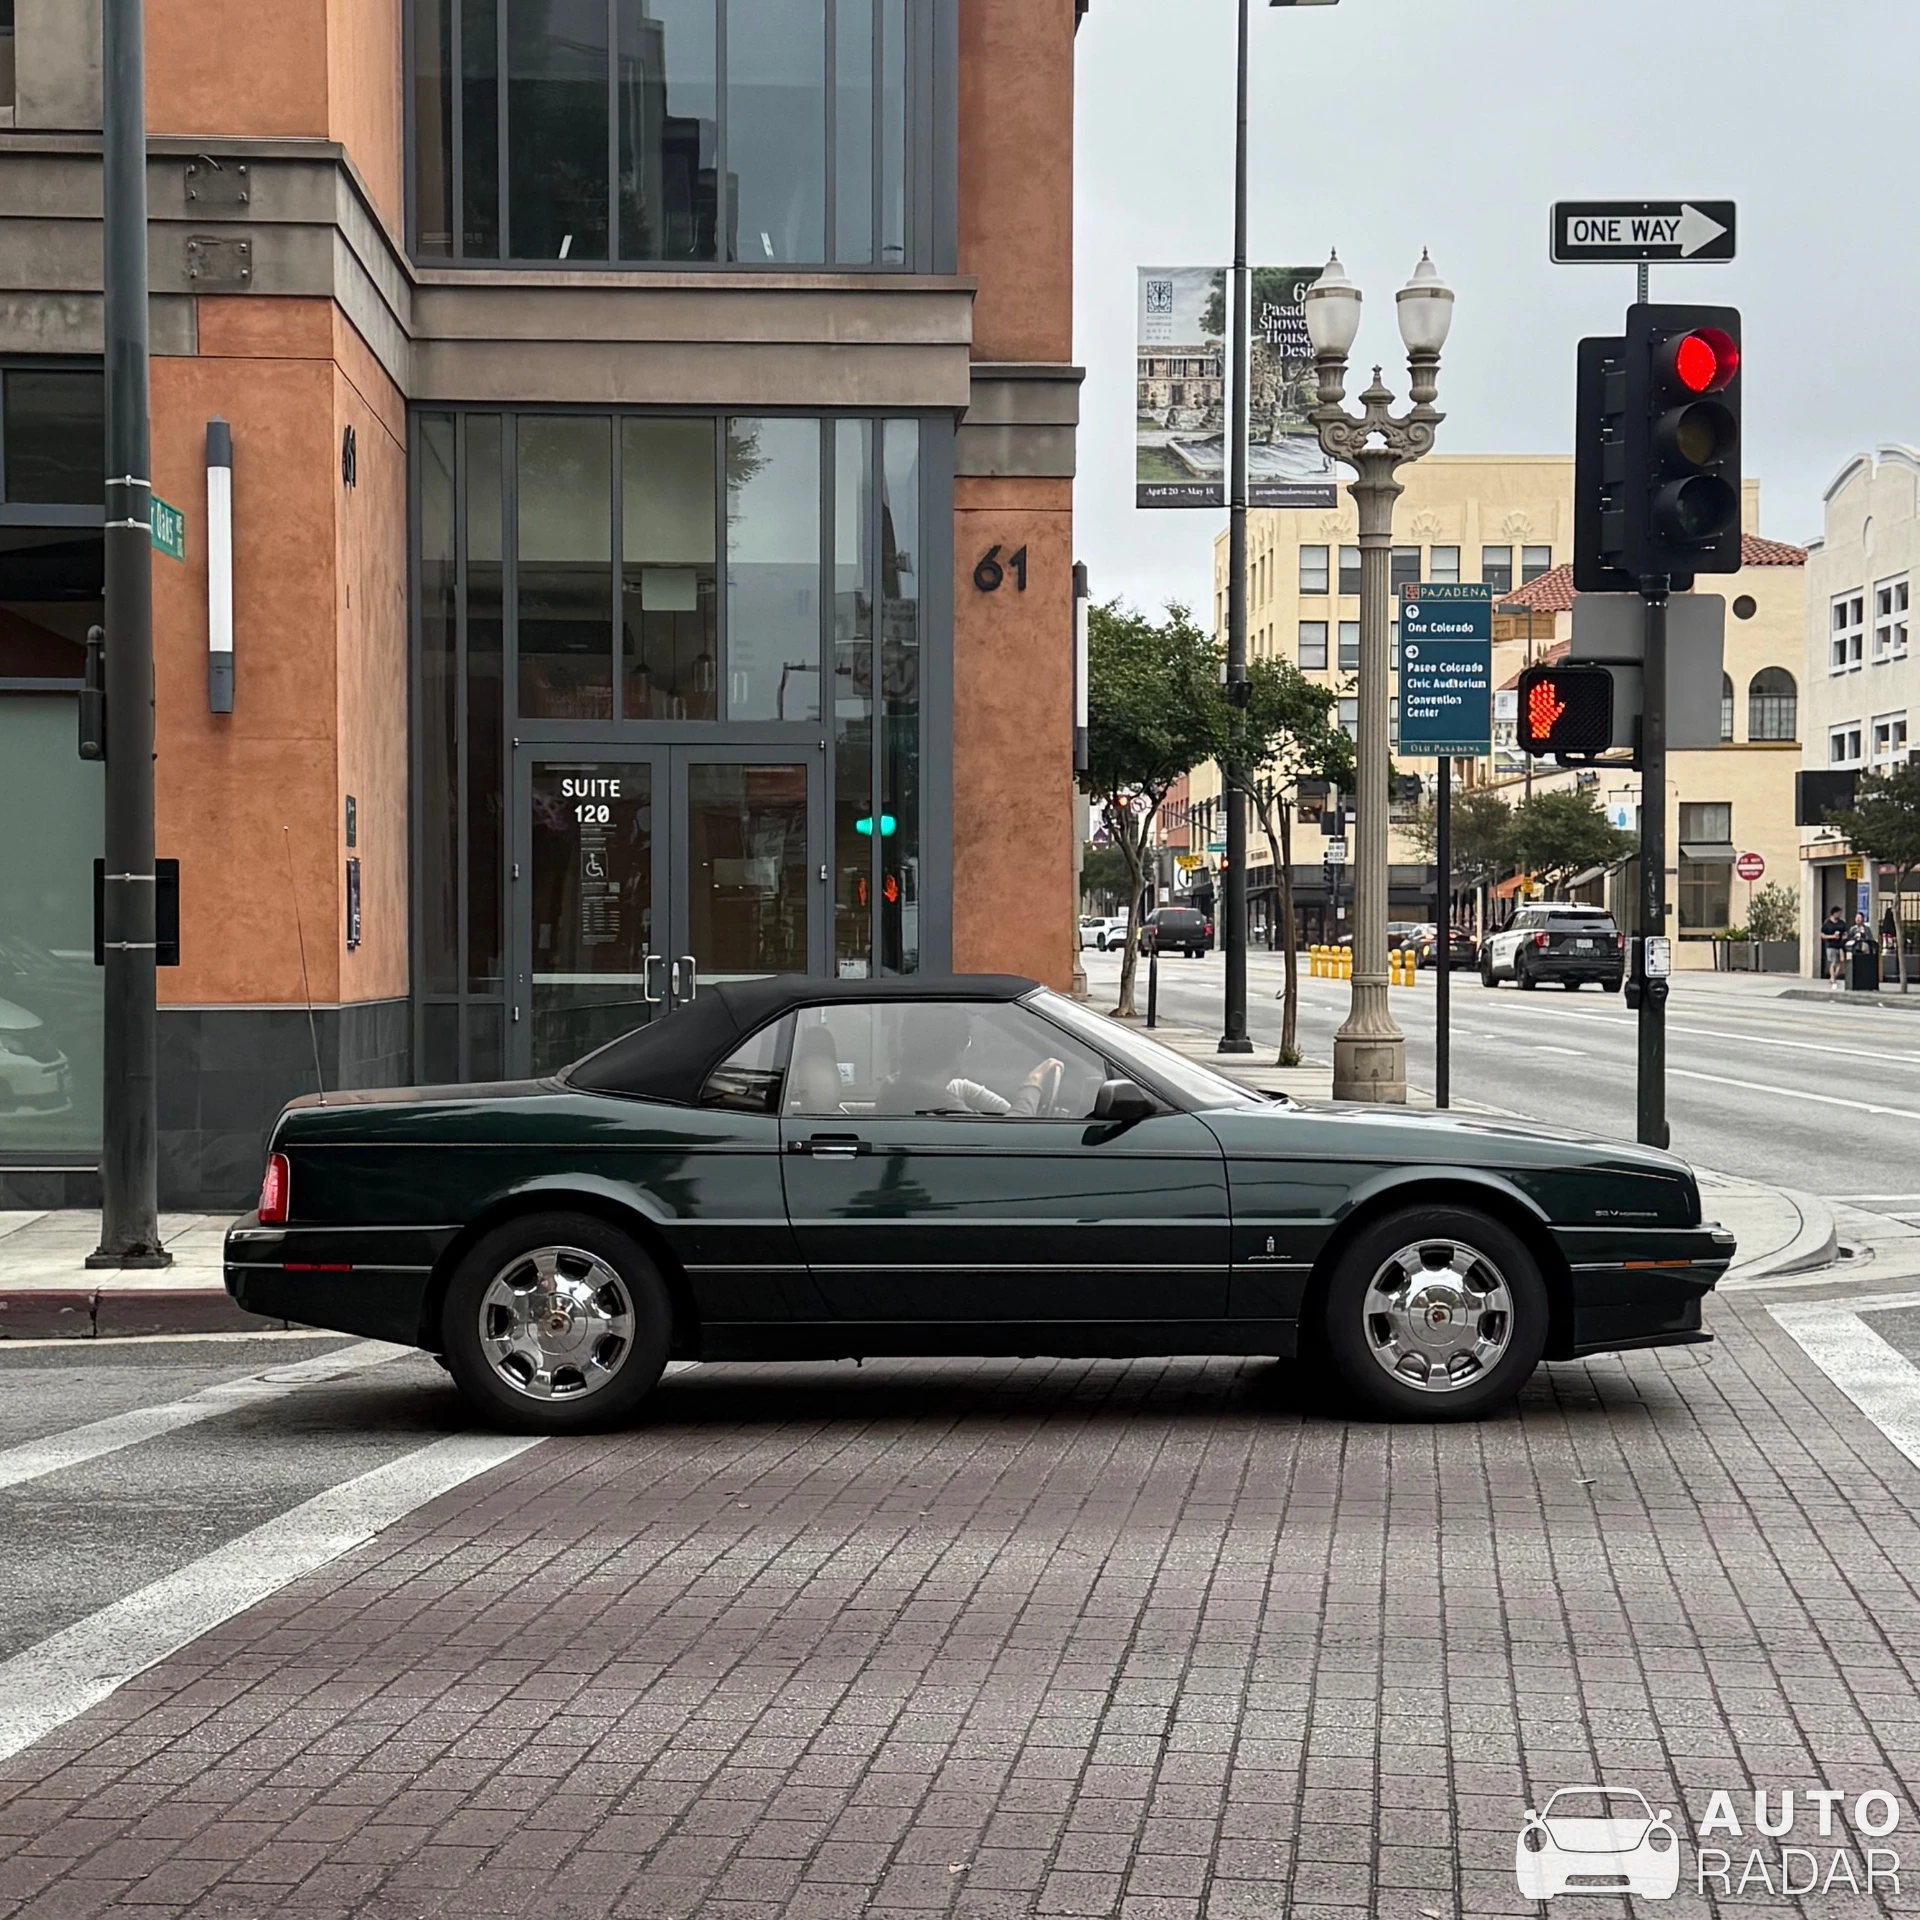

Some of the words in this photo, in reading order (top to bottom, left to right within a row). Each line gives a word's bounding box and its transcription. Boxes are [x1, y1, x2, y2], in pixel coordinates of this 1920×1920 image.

[1574, 219, 1621, 242] ONE
[1631, 219, 1681, 242] WAY
[1293, 282, 1314, 302] 6
[1262, 302, 1305, 316] Pasad
[1259, 315, 1307, 330] Showc
[1280, 343, 1316, 359] Desi
[973, 544, 1027, 592] 61
[1420, 587, 1488, 597] PASADENA
[1407, 622, 1427, 633] One
[1430, 622, 1474, 633] Colorado
[1407, 662, 1436, 673] Paseo
[1439, 662, 1483, 673] Colorado
[1407, 678, 1431, 689] Civic
[1433, 678, 1487, 689] Auditorium
[1407, 694, 1462, 705] Convention
[1407, 707, 1439, 718] Center
[561, 778, 621, 798] SUITE
[574, 804, 610, 823] 120
